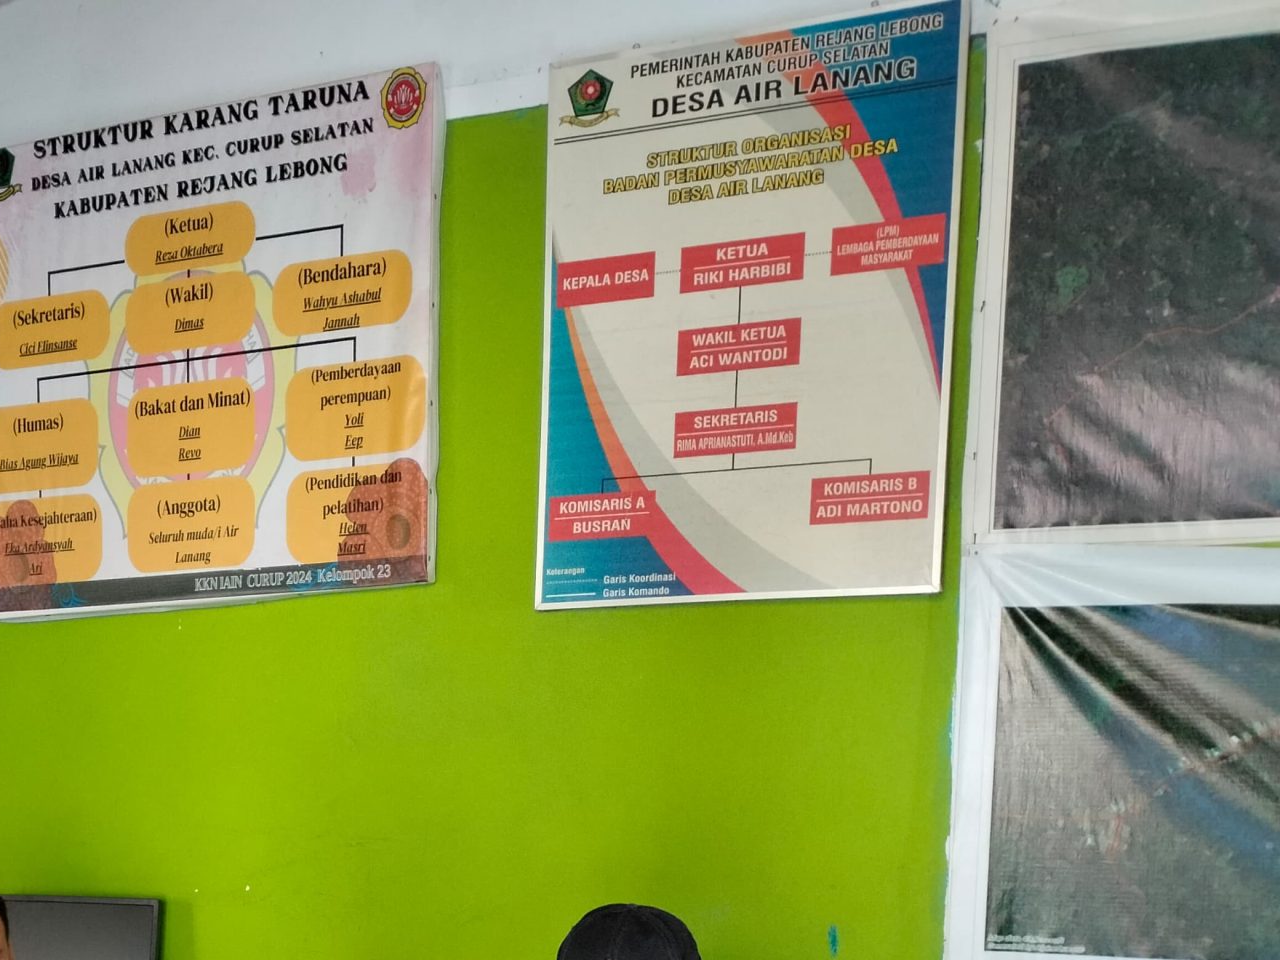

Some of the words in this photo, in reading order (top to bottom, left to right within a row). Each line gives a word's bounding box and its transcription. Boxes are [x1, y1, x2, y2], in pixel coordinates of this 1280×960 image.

[630, 51, 720, 78] PEMERINTAH
[725, 37, 811, 64] KABUPATEN
[815, 26, 874, 50] REJANG
[879, 13, 943, 41] LEBONG
[676, 64, 763, 89] KECAMATAN
[766, 54, 818, 75] CURUP
[823, 41, 889, 65] SELATAN
[651, 88, 725, 118] DESA
[734, 78, 782, 108] AIR
[794, 57, 917, 96] LANANG
[33, 116, 154, 160] STRUKTUR
[164, 101, 259, 135] KARANG
[268, 80, 370, 117] TARUNA
[31, 169, 72, 192] DESA
[77, 162, 106, 184] AIR
[111, 152, 176, 178] LANANG
[182, 144, 220, 165] KEC.
[225, 134, 284, 158] CURUP
[290, 117, 374, 147] SELATAN
[646, 141, 736, 168] STRUKTUR
[741, 125, 851, 155] ORGANISASI
[603, 174, 659, 194] BADAN
[664, 146, 844, 188] PERMUSYAWARATAN
[849, 138, 898, 158] DESA
[54, 181, 168, 219] KABUPATEN
[176, 168, 258, 199] REJANG
[265, 153, 348, 184] LEBONG
[668, 187, 713, 205] DESA
[719, 180, 748, 198] AIR
[751, 169, 824, 195] LANANG
[164, 212, 214, 238] (Ketua)
[877, 225, 900, 240] (LPM)
[716, 243, 769, 261] KETUA
[837, 241, 874, 256] LEMBAGA
[875, 233, 939, 251] PEMBERDAYAAN
[155, 248, 178, 265] Reza
[861, 249, 914, 266] MASYARAKAT
[297, 257, 387, 289] (Bendahara)
[562, 273, 612, 291] KEPALA
[615, 269, 649, 286] DESA
[693, 269, 725, 286] RIKI
[729, 261, 791, 282] HARBIBI
[165, 282, 214, 308] (Wakil)
[302, 295, 338, 312] Wahyu
[340, 287, 382, 309] Ashabul
[12, 301, 85, 330] (Sekretaris)
[174, 317, 204, 333] Dimas
[322, 314, 360, 332] Jannah
[692, 329, 737, 347] WAKIL
[740, 324, 787, 342] KETUA
[690, 353, 714, 370] ACI
[718, 347, 788, 367] WANTODI
[311, 361, 401, 384] (Pemberdayaan
[134, 399, 176, 419] (Bakat
[180, 395, 204, 412] dan
[208, 389, 251, 408] Minat)
[320, 386, 391, 410] perempuan)
[13, 413, 64, 436] (Humas)
[344, 413, 364, 428] Yoli
[694, 409, 778, 429] SEKRETARIS
[178, 426, 200, 440] Dian
[345, 435, 363, 449] Eep
[178, 448, 202, 462] Revo
[677, 438, 697, 452] RIMA
[0, 458, 18, 472] Bias
[20, 456, 47, 471] Agung
[48, 452, 79, 468] Wijaya
[305, 471, 377, 494] (Pendidikan
[380, 470, 402, 484] dan
[824, 479, 904, 496] KOMISARIS
[908, 477, 918, 491] B
[157, 495, 221, 518] (Anggota)
[323, 497, 384, 519] pelatihan)
[559, 496, 632, 515] KOMISARIS
[635, 496, 646, 509] A
[816, 502, 842, 519] ADI
[846, 499, 923, 516] MARTONO
[149, 528, 184, 544] Seluruh
[223, 525, 238, 537] Air
[572, 518, 631, 534] BUSRAN
[176, 552, 211, 565] Lanang
[194, 576, 219, 591] KKN
[220, 575, 242, 589] IAIN
[246, 572, 284, 588] CURUP
[286, 570, 312, 585] 2024
[317, 565, 375, 583] Kelompok
[376, 564, 391, 578] 23
[603, 575, 626, 585] Garis
[629, 571, 676, 583] Koordinasi
[603, 588, 626, 598] Garis
[628, 586, 670, 596] Komando
